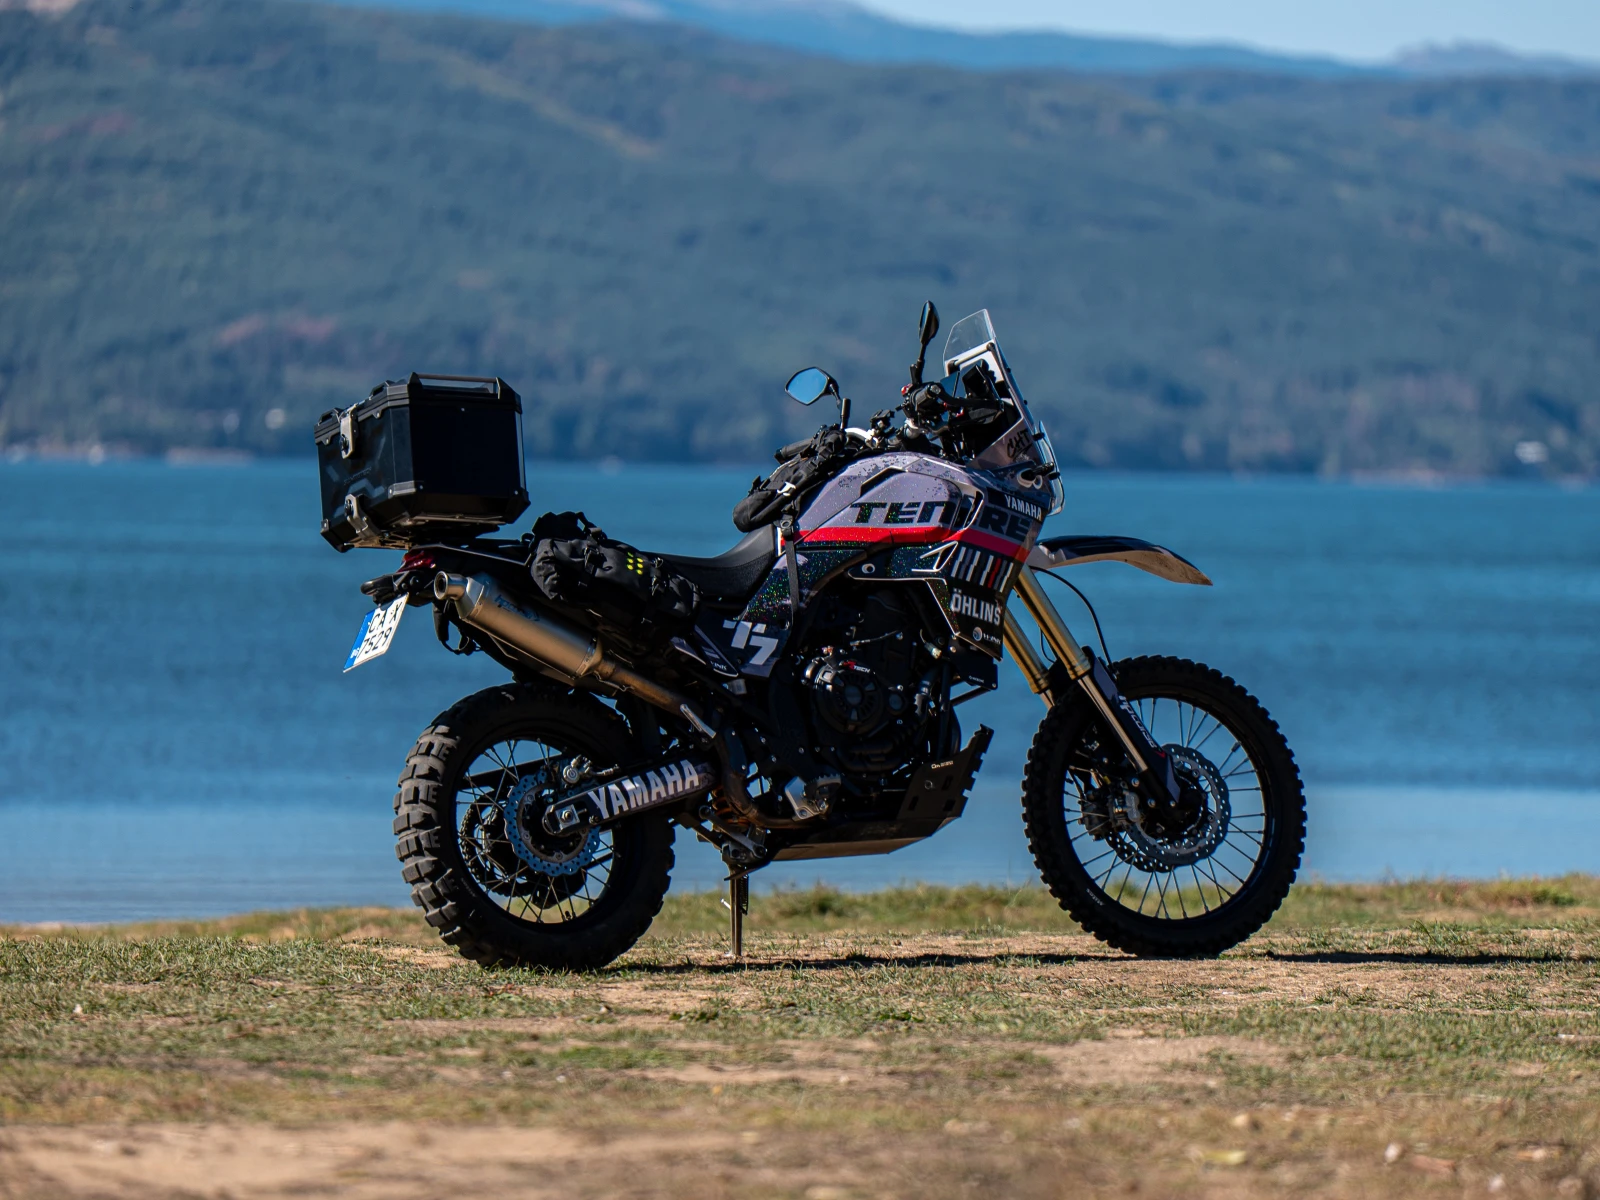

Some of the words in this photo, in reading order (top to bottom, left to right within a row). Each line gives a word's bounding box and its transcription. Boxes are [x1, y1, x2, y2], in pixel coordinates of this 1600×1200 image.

[1004, 494, 1042, 522] YAMAHA
[950, 587, 1002, 626] ÖHLINS
[357, 627, 392, 658] 7529
[588, 759, 699, 820] YAMAHA
